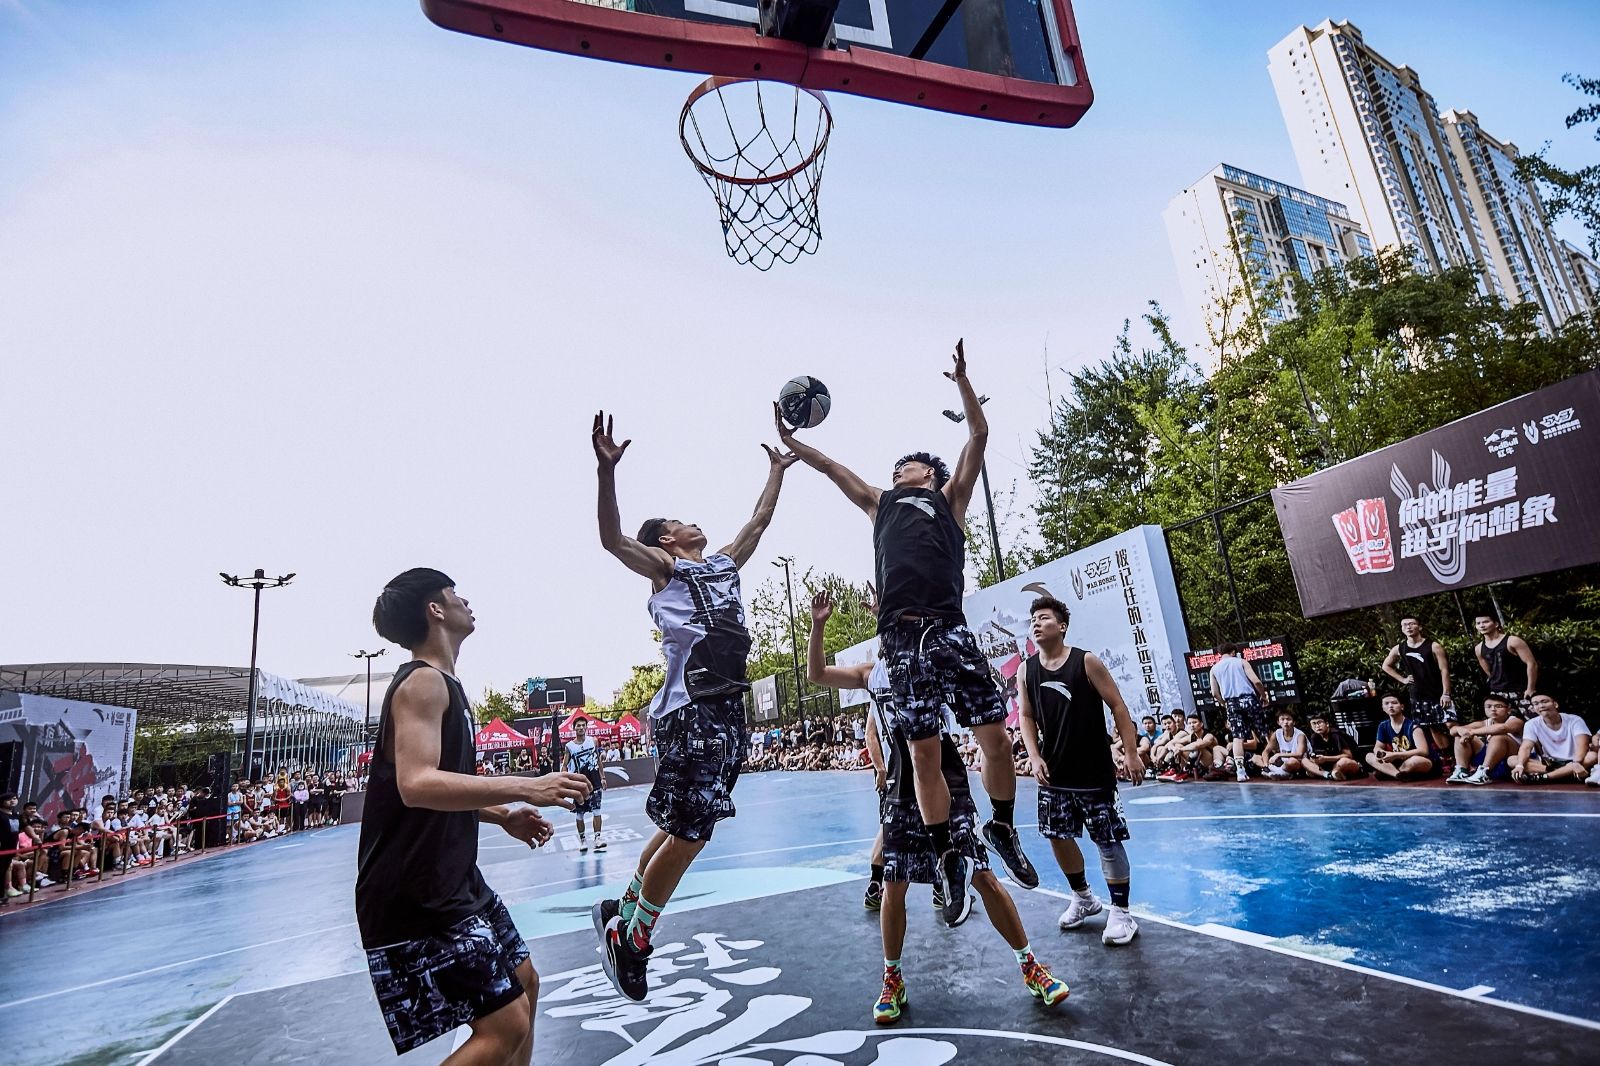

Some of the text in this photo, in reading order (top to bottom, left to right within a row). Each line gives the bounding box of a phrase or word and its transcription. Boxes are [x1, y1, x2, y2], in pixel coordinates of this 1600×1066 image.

[1497, 446, 1515, 458] 红牛
[1399, 465, 1518, 528] 你的能量
[1400, 493, 1559, 560] 超乎你想象
[1115, 548, 1164, 726] 被记住的永远是疯子
[1273, 661, 1285, 681] 2
